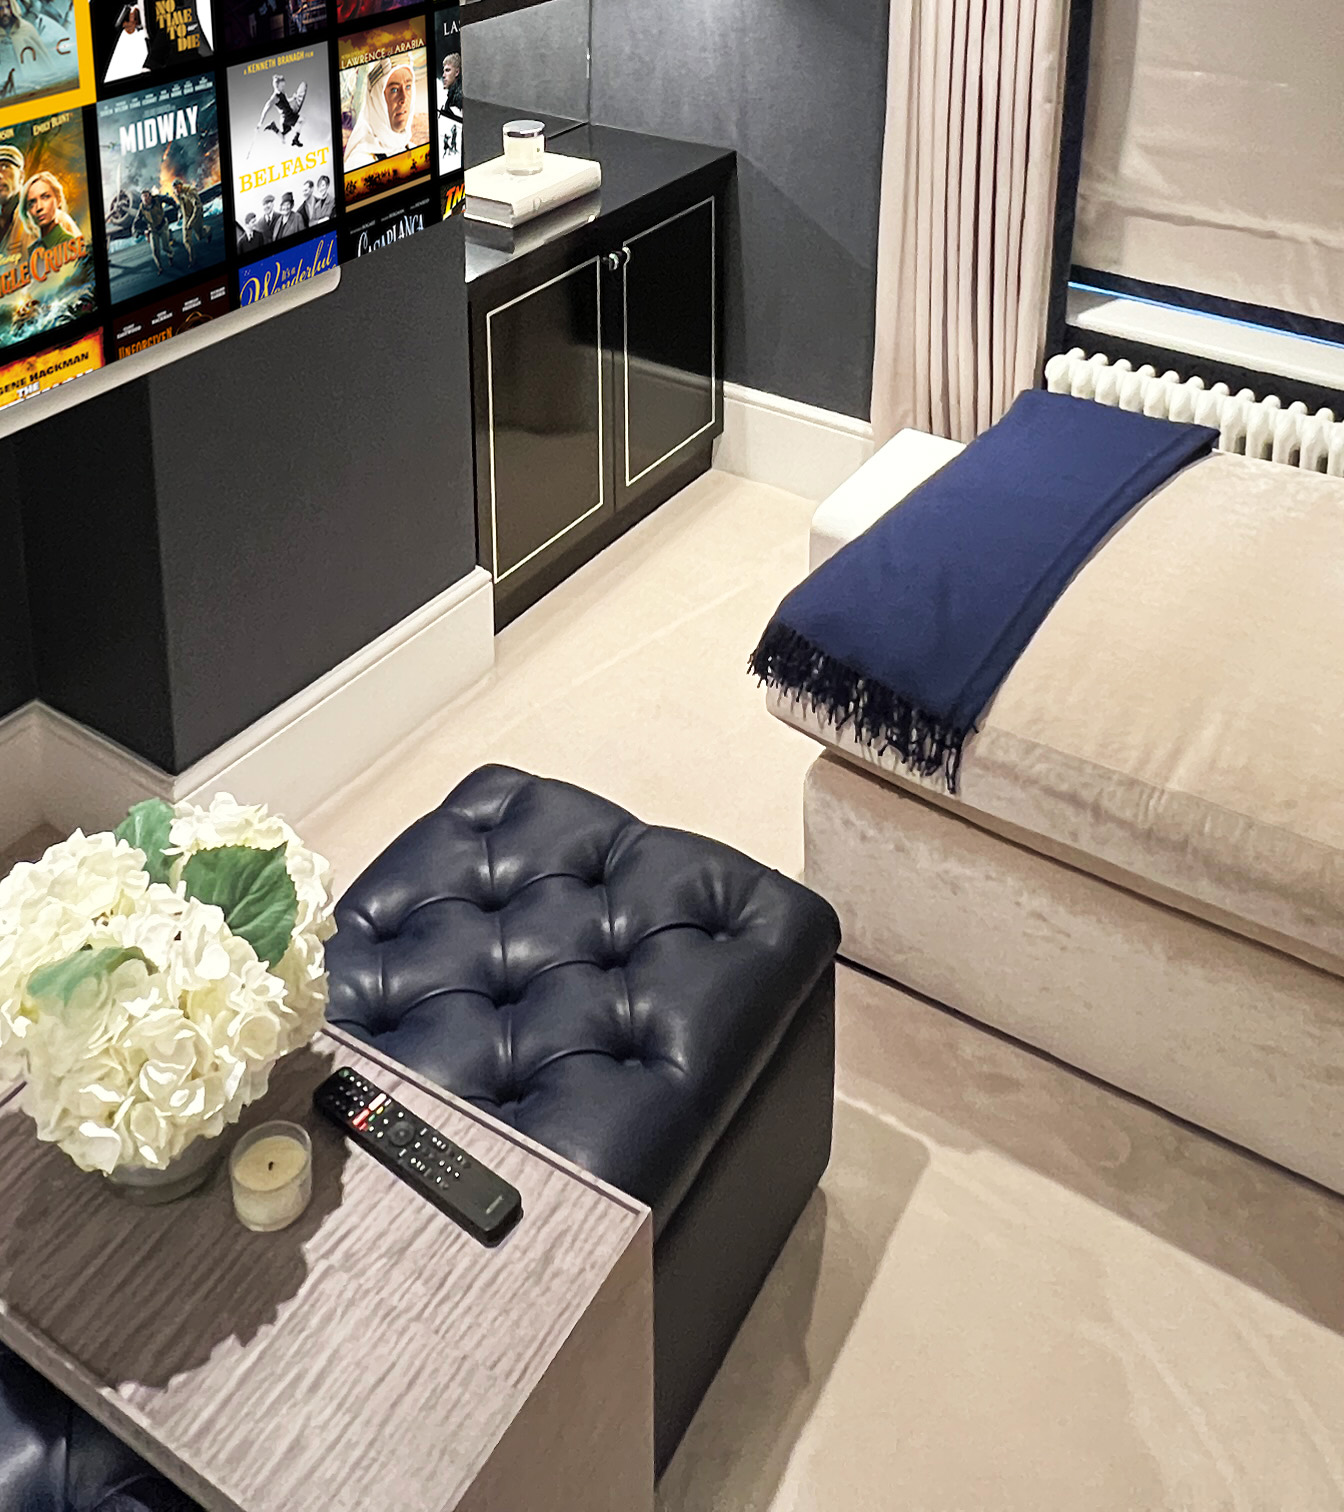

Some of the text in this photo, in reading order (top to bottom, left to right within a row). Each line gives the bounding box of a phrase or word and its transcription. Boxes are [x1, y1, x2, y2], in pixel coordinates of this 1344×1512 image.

[156, 8, 193, 29] TIME
[167, 23, 187, 40] TO
[177, 34, 201, 52] DIE
[341, 48, 386, 69] LAWRENCE
[395, 39, 425, 54] ARABIA
[247, 58, 276, 74] KENNETH
[277, 51, 305, 66] BRANAGH
[119, 104, 199, 157] MIDWAY
[238, 146, 330, 194] BELFAST
[30, 236, 87, 282] CRUISE
[29, 352, 89, 382] HACKMAN
[16, 381, 40, 399] THE
